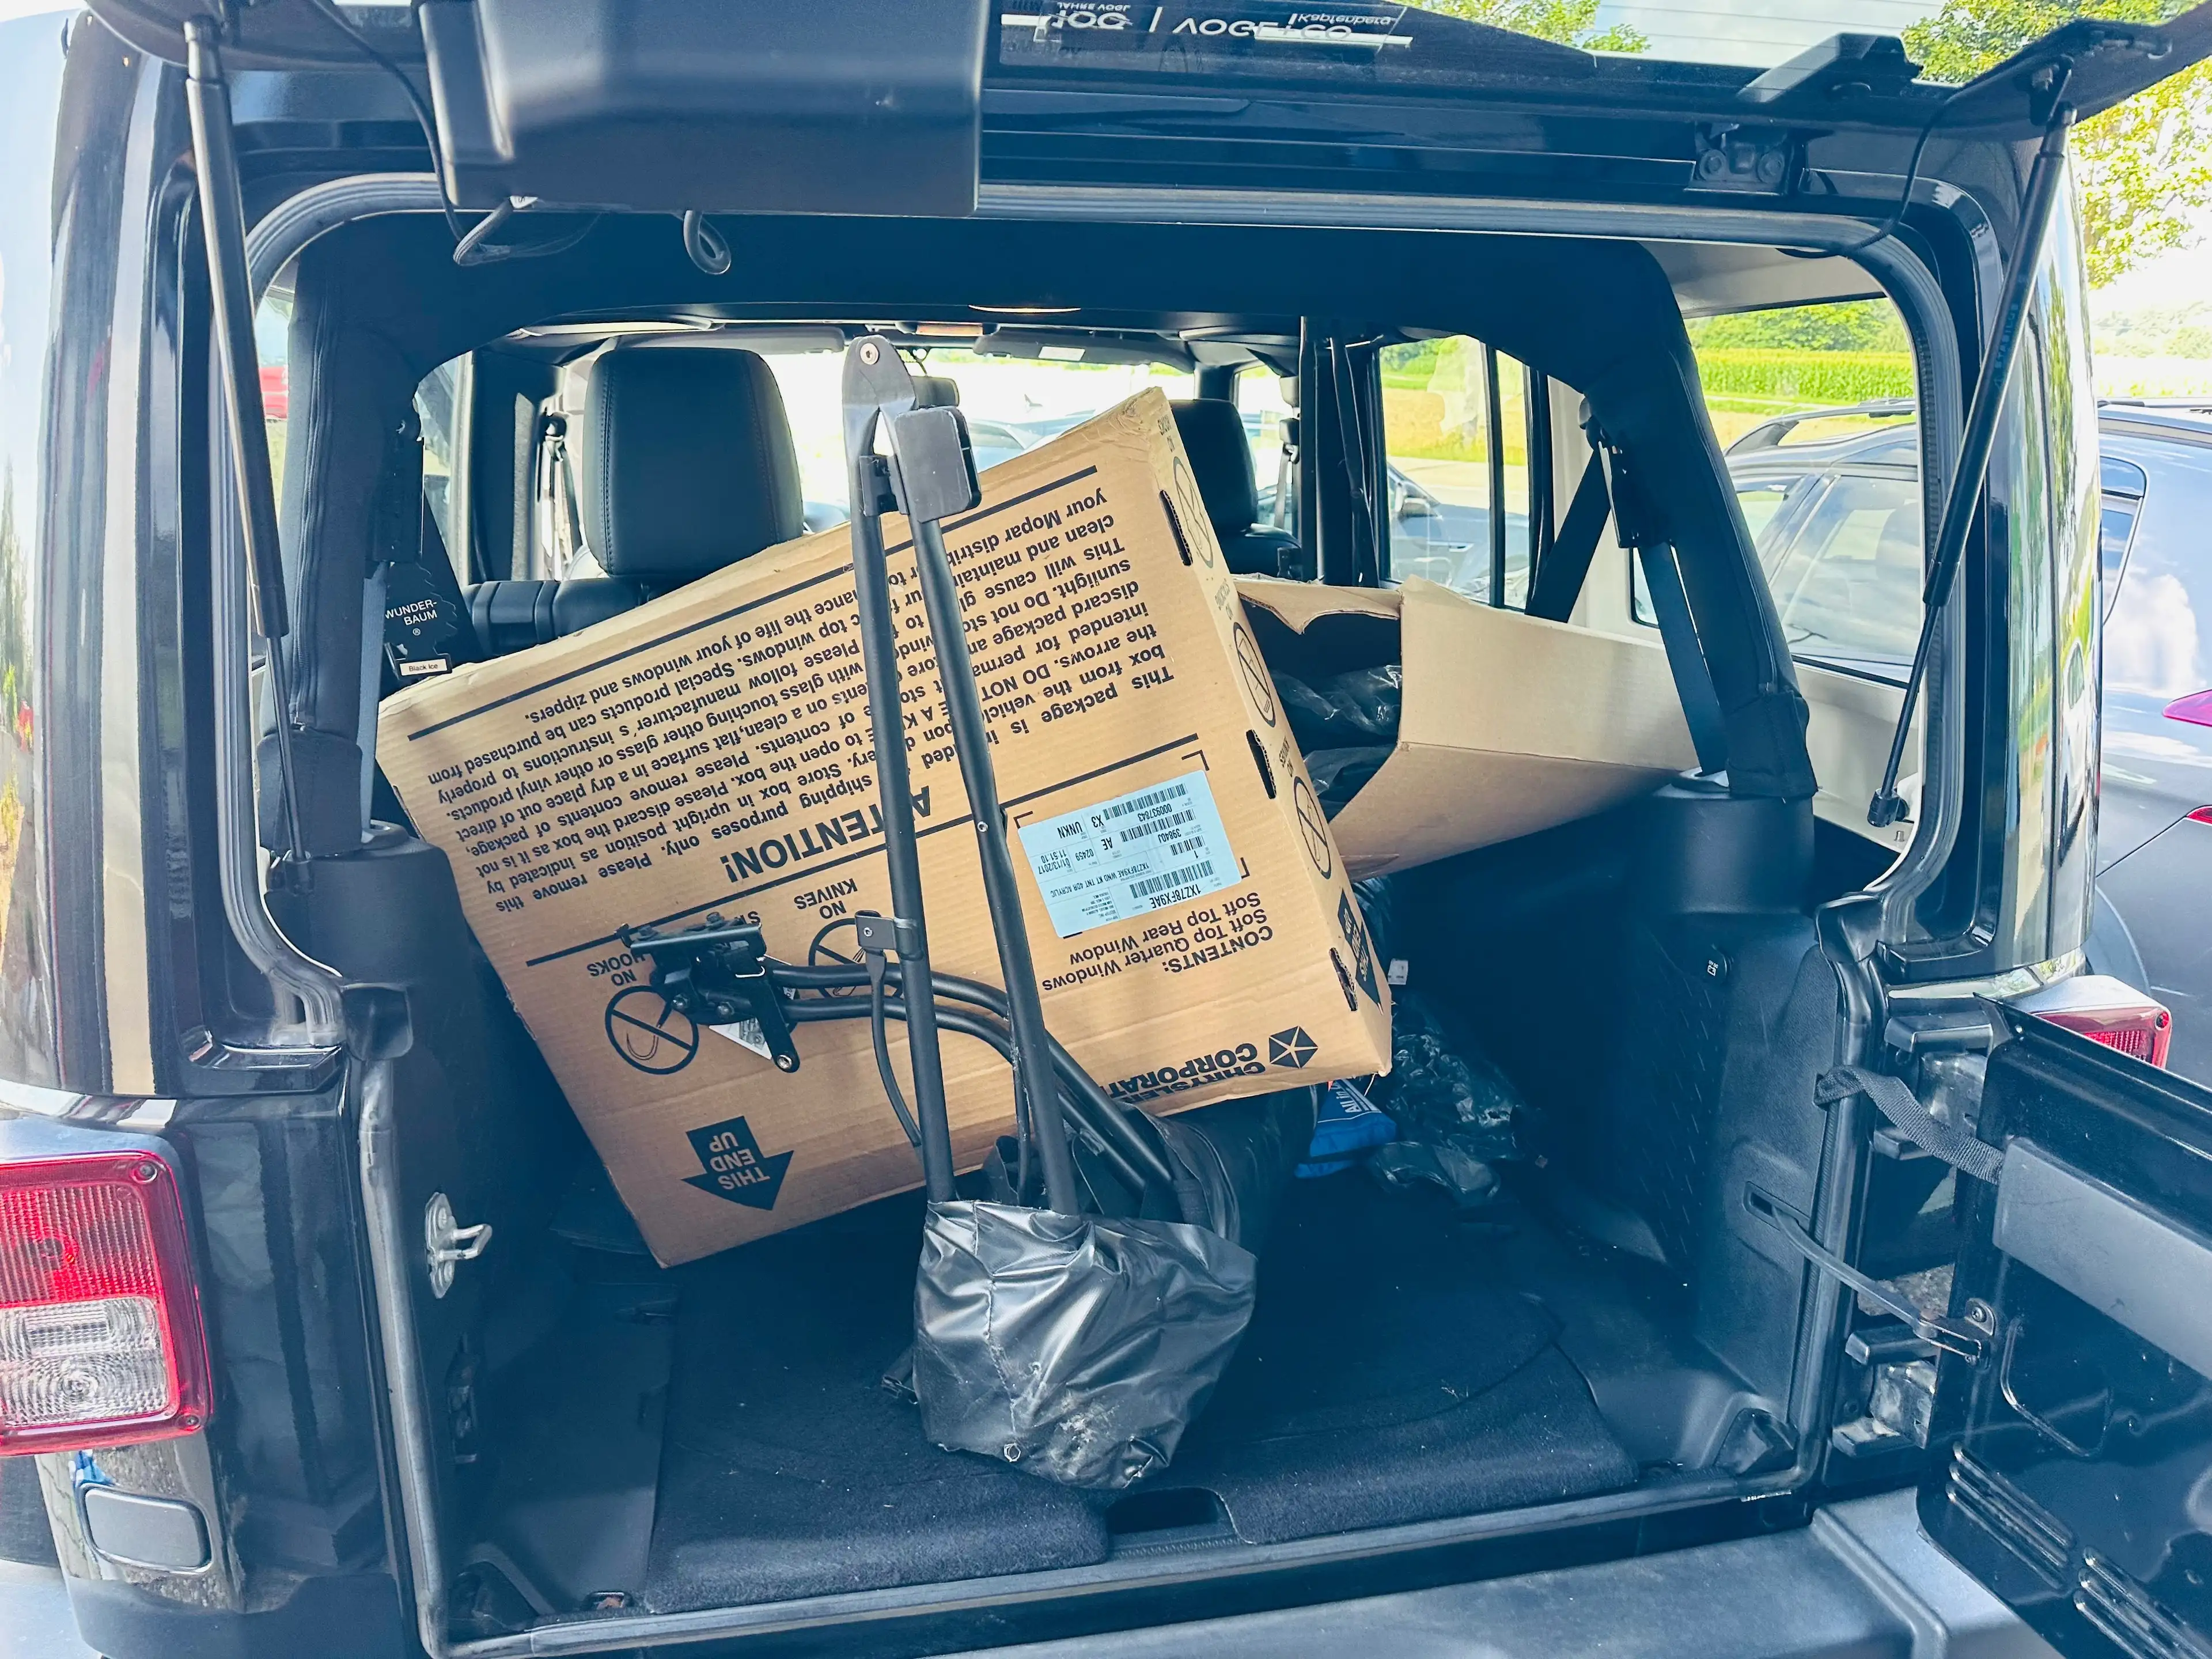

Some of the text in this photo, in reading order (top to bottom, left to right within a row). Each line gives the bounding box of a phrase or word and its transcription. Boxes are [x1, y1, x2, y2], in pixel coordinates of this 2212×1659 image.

[1083, 537, 1126, 560] This
[1043, 555, 1077, 580] will
[1052, 559, 1131, 599] sunlight.
[984, 571, 1036, 599] cause
[385, 599, 437, 619] WUNDER-
[524, 487, 1108, 724] your Mopar to the life of your windows and zippers.
[1024, 590, 1051, 608] Do
[1070, 581, 1139, 619] discard
[403, 609, 438, 626] BAUM
[905, 614, 925, 630] to
[990, 601, 1021, 624] not
[1068, 602, 1149, 645] intended
[993, 604, 1067, 645] package
[1126, 624, 1157, 643] the
[427, 514, 1114, 785] clean and top windows. Special products can be purchased from
[804, 639, 860, 668] Please
[1035, 635, 1061, 654] for
[1054, 637, 1121, 668] arrows.
[408, 664, 427, 672] Black
[748, 662, 798, 690] follow
[827, 662, 864, 684] with
[1022, 664, 1051, 685] DO
[779, 673, 824, 700] glass
[981, 676, 1019, 702] NOT
[706, 694, 779, 728] touching
[805, 698, 828, 714] on
[920, 706, 933, 722] A
[662, 721, 704, 744] other
[838, 712, 855, 730] of
[616, 734, 659, 760] glass
[755, 721, 830, 754] contents.
[844, 733, 863, 747] to
[522, 730, 615, 772] instructions
[597, 754, 613, 768] or
[651, 741, 710, 771] surface
[799, 740, 840, 763] open
[487, 644, 1165, 894] box from the Store box in upright position as indicated by
[502, 766, 520, 779] to
[554, 761, 594, 784] other
[631, 764, 650, 778] in
[695, 750, 751, 778] Please
[769, 756, 797, 774] the
[438, 770, 497, 804] properly
[590, 776, 615, 794] dry
[629, 772, 688, 801] remove
[730, 767, 767, 786] box.
[495, 666, 1175, 912] This package is shipping purposes only. Please remove this
[515, 777, 552, 800] vinyl
[546, 783, 587, 809] place
[674, 781, 729, 807] Please
[446, 786, 514, 821] products.
[517, 802, 543, 821] out
[557, 796, 623, 827] contents
[1136, 802, 1173, 823] 000937843
[499, 812, 515, 828] of
[612, 801, 671, 832] discard
[1089, 813, 1105, 829] X3
[456, 819, 497, 842] direct
[465, 825, 529, 857] package,
[534, 821, 551, 838] of
[552, 832, 584, 850] box
[584, 823, 611, 839] the
[718, 785, 932, 884] ATENTION!
[1056, 820, 1084, 839] UNKN
[1156, 827, 1182, 844] 39840J
[532, 843, 551, 857] as
[1074, 847, 1095, 862] 02459
[1100, 836, 1115, 851] AE
[1192, 849, 1199, 859] 1
[502, 855, 518, 868] is
[517, 850, 532, 864] it
[1036, 857, 1071, 876] 01/13/2017
[475, 861, 500, 878] not
[1095, 876, 1104, 884] KT
[1103, 871, 1118, 882] WND
[1116, 861, 1150, 878] 1XZ78FX9AE
[791, 877, 858, 911] KNIVES
[1049, 884, 1073, 898] ACRYLIC
[1084, 878, 1096, 888] TNT
[1148, 882, 1202, 910] 1XZ78FX9AE
[817, 899, 847, 921] NO
[1343, 908, 1351, 934] UP
[1067, 891, 1262, 967] Soft Top Rear Window
[1040, 908, 1268, 994] Soft Top Quarter Windows
[1163, 925, 1274, 973] CONTENTS:
[1351, 924, 1361, 959] END
[1359, 945, 1369, 982] THIS
[611, 969, 637, 986] NO
[709, 1131, 739, 1153] UP
[709, 1148, 756, 1172] END
[717, 1166, 771, 1190] THIS
